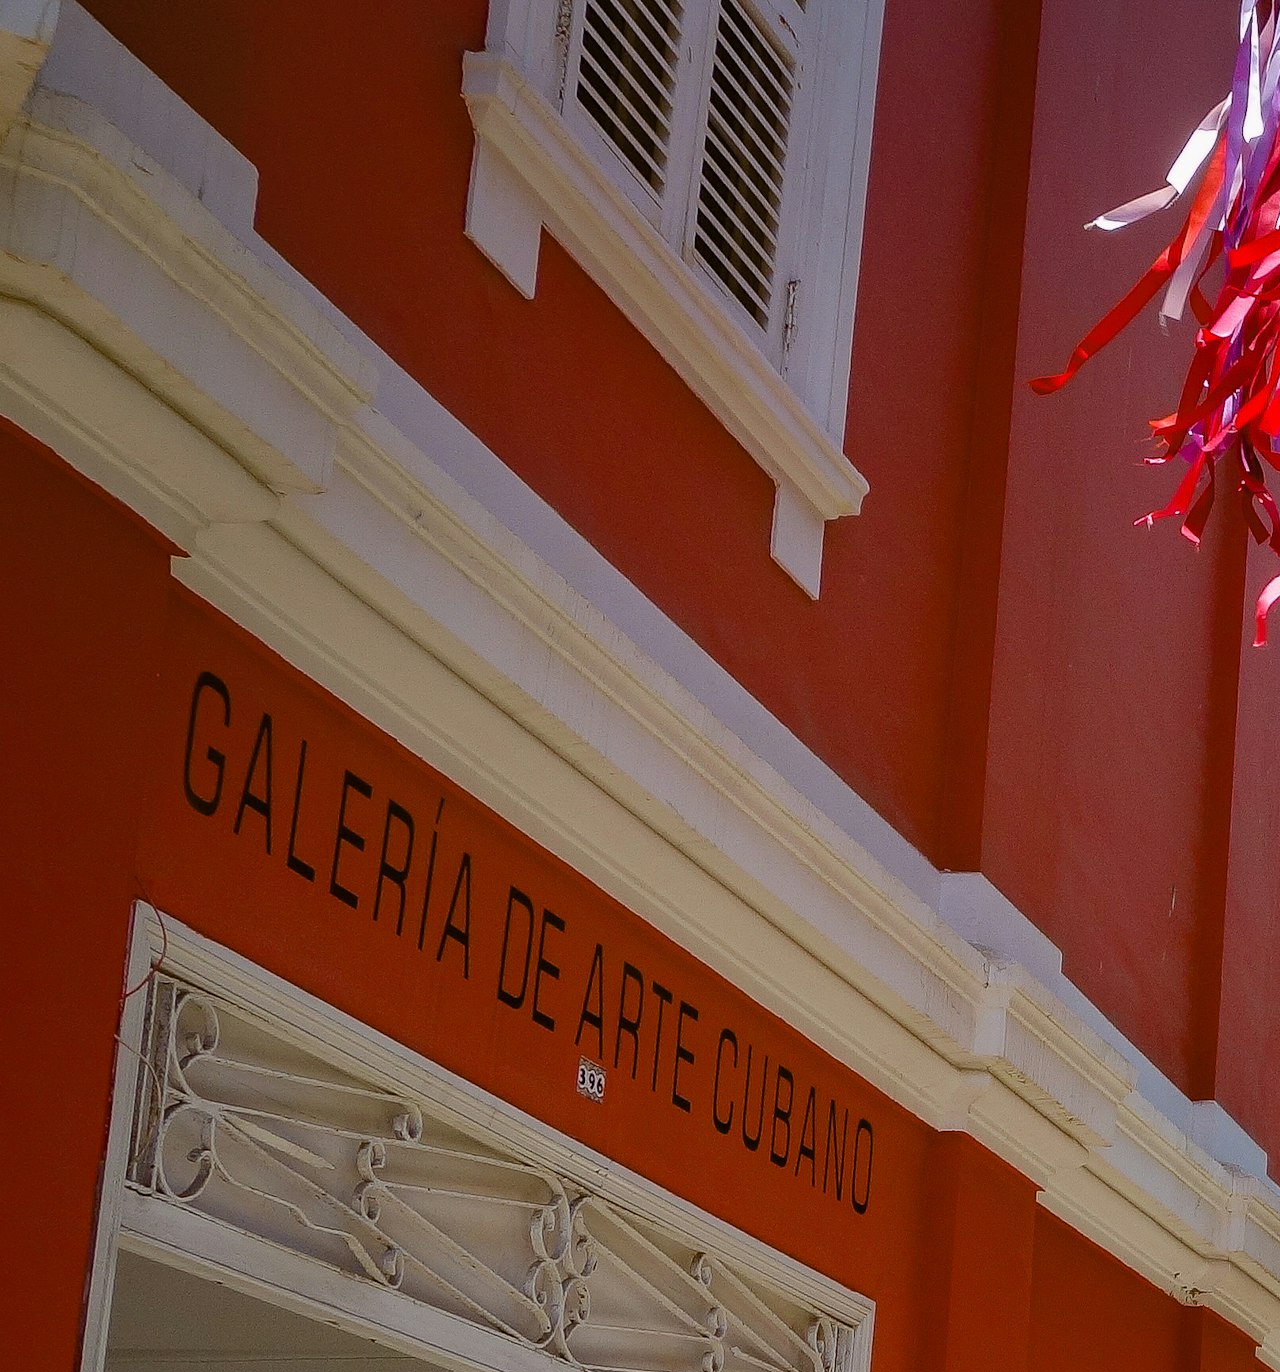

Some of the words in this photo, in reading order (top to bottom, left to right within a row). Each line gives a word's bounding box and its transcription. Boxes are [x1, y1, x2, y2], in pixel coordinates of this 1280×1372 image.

[184, 671, 472, 980] GALERÍA
[497, 885, 566, 1032] DE
[575, 943, 699, 1114] ARTE
[712, 1028, 873, 1216] CUBANO
[579, 1068, 603, 1094] 396
